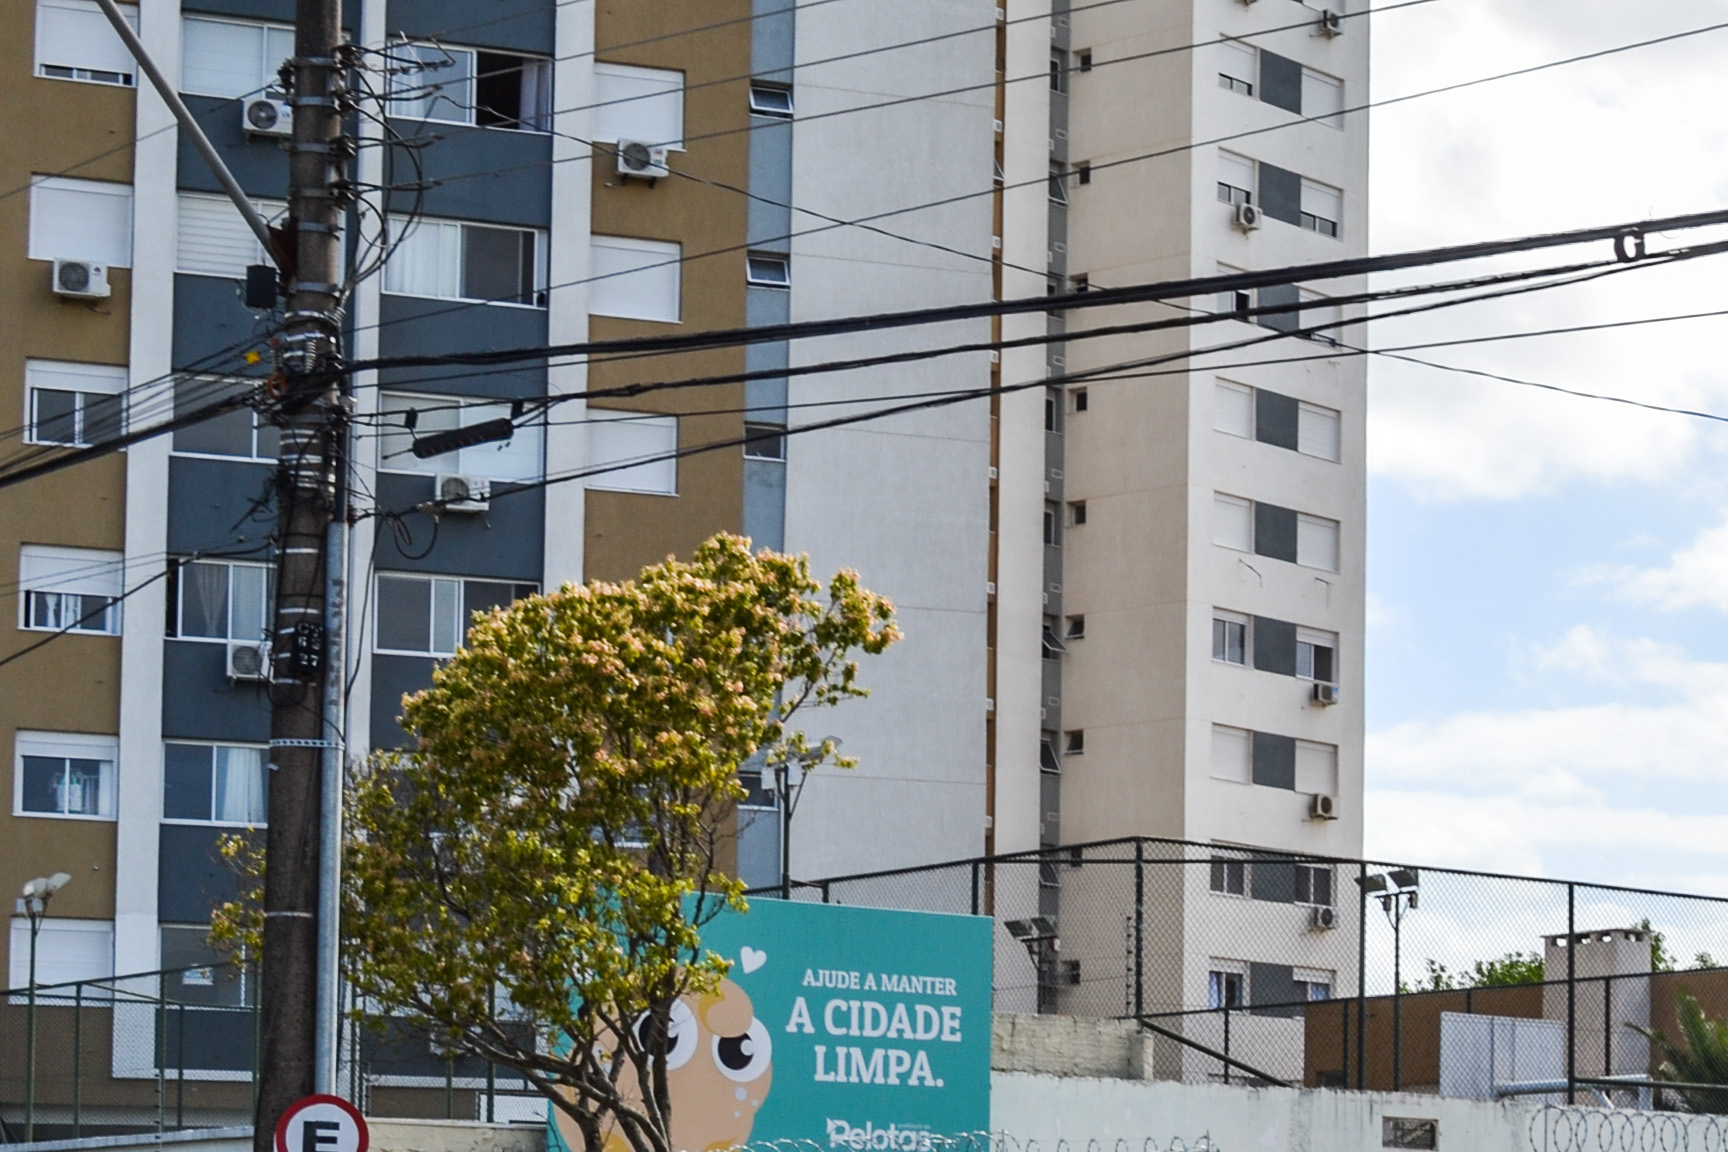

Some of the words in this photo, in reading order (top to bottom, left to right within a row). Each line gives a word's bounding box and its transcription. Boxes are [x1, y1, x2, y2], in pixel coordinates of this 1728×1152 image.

[802, 968, 860, 990] AJUDE
[864, 972, 878, 991] A
[881, 973, 957, 996] MANTER
[785, 996, 815, 1034] A
[824, 998, 962, 1042] CIDADE
[814, 1045, 944, 1088] LIMPA.
[826, 1117, 931, 1152] Pelotas
